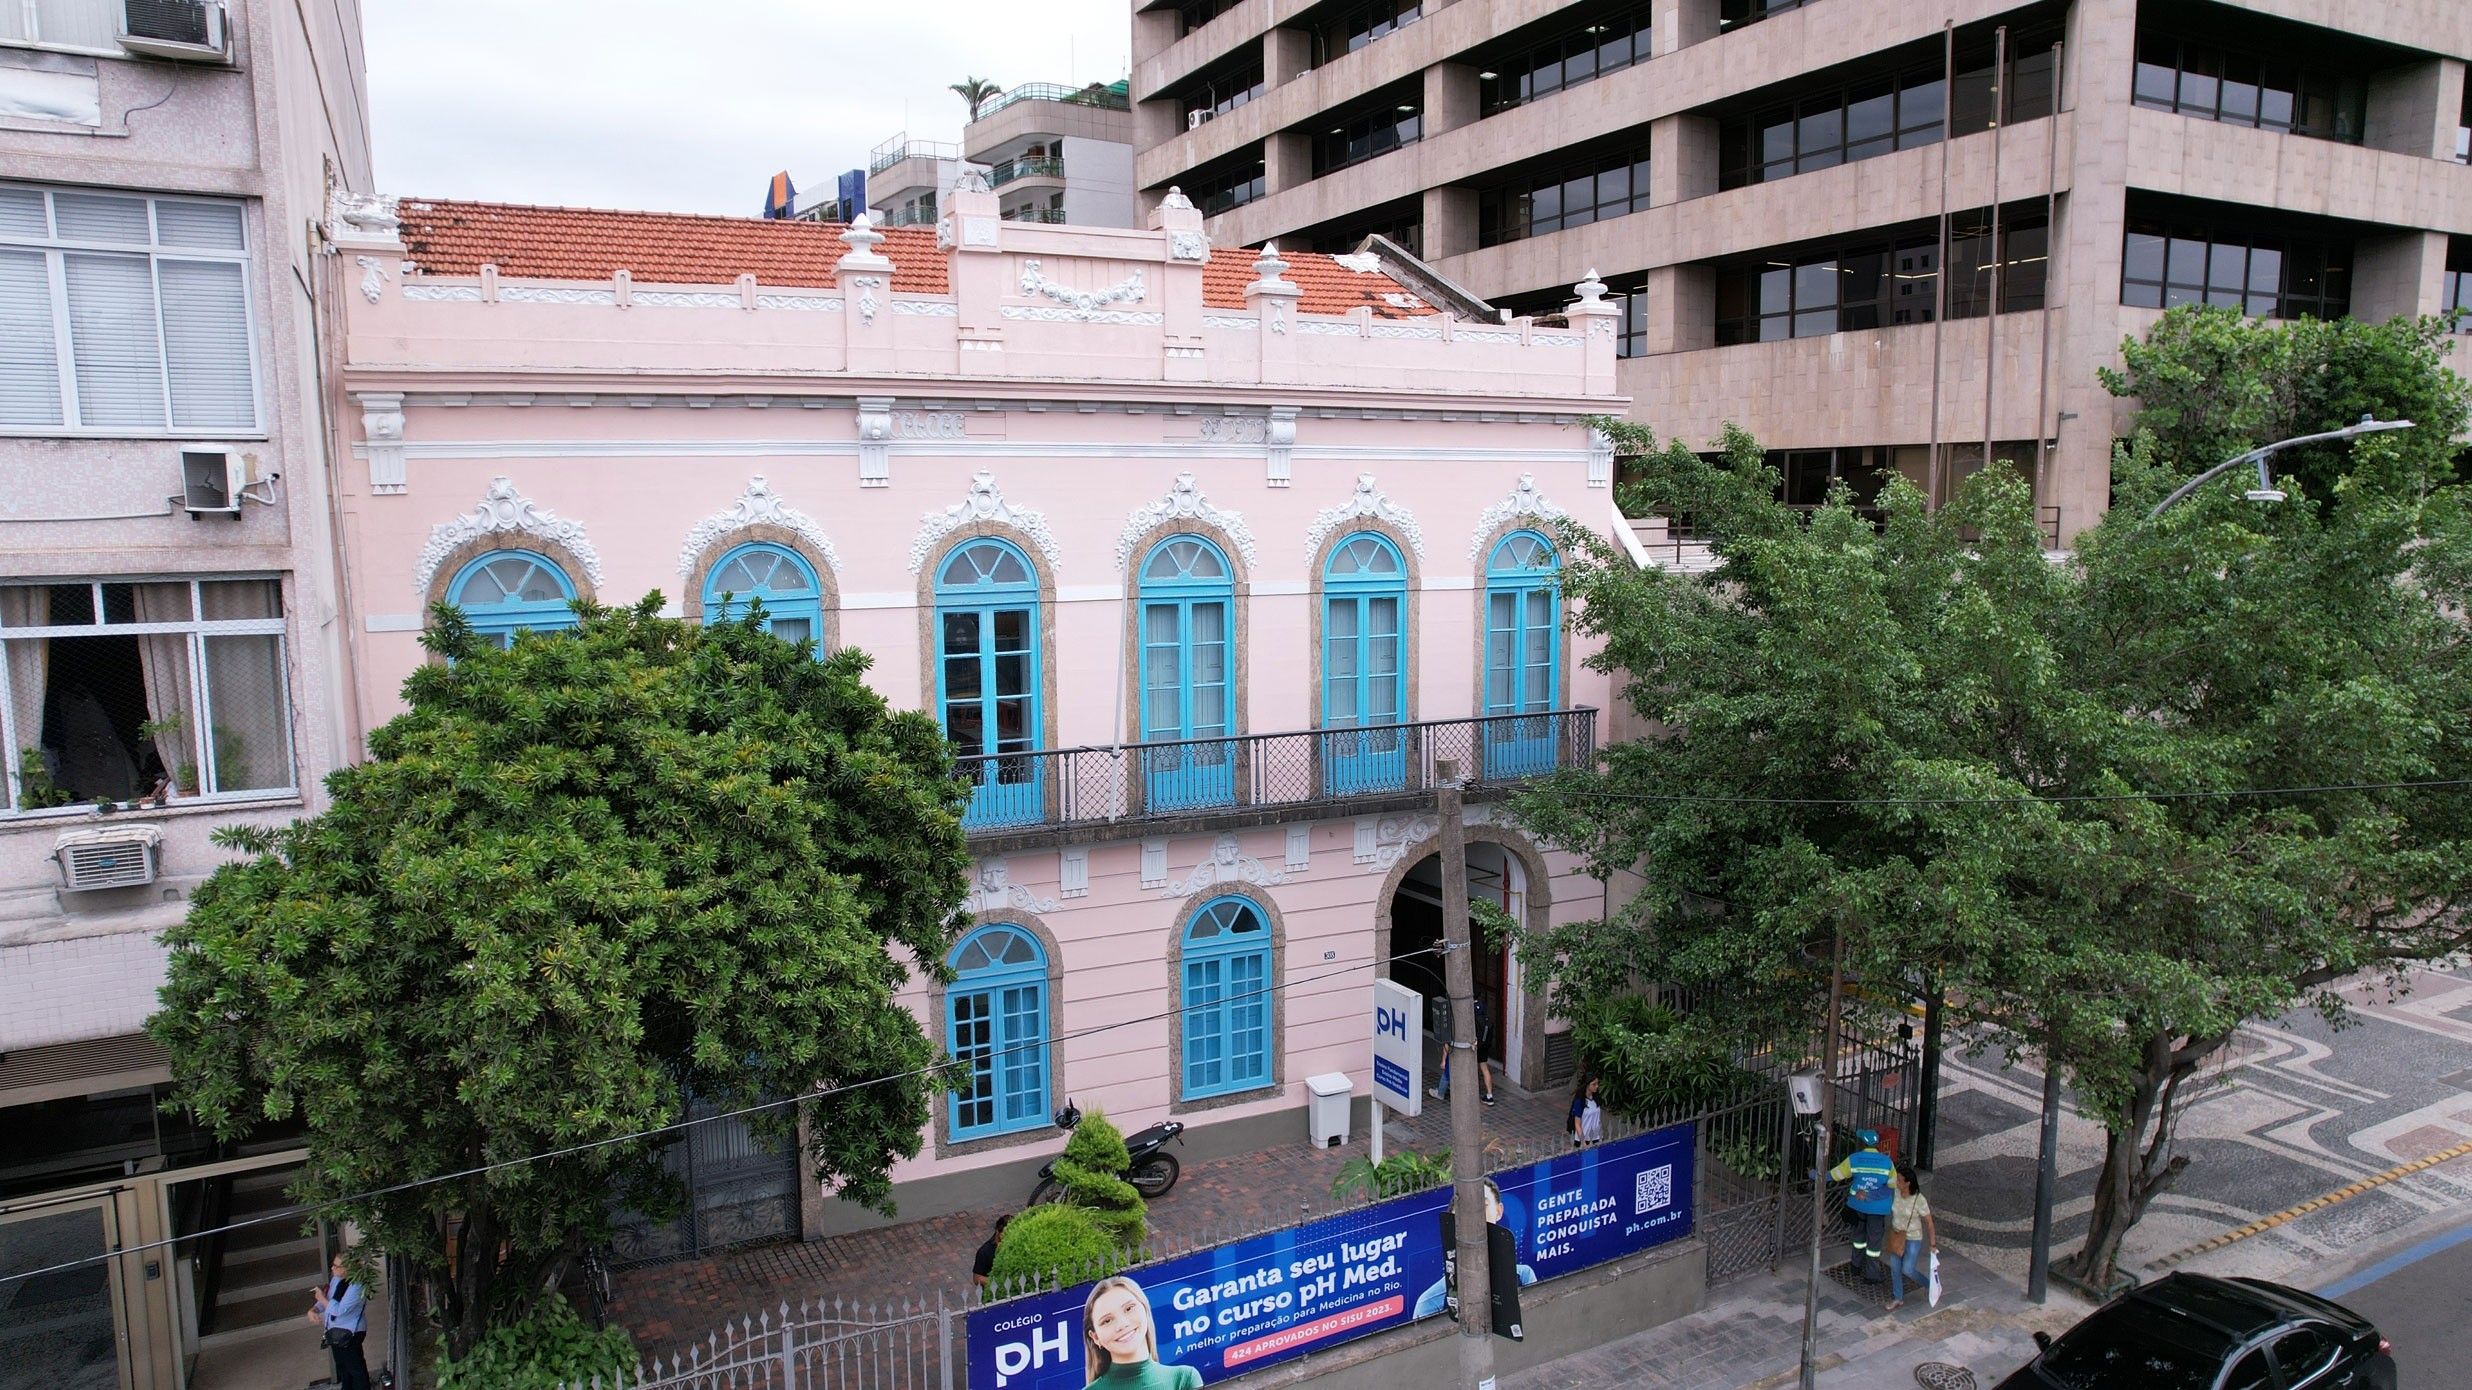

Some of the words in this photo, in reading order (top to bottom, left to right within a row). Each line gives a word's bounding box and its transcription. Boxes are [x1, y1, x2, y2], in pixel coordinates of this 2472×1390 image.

[1376, 1006, 1406, 1042] pH
[1538, 1197, 1616, 1227] PREPARADA
[1539, 1189, 1582, 1210] GENTE
[1537, 1214, 1616, 1244] CONQUISTA
[1626, 1211, 1682, 1236] ph.com.br
[1537, 1243, 1574, 1261] MAIS.
[1173, 1268, 1282, 1310] Garanta
[1290, 1253, 1334, 1278] seu
[1341, 1232, 1407, 1263] lugar
[1174, 1316, 1210, 1339] no
[1218, 1292, 1292, 1325] curso
[1300, 1272, 1336, 1306] pH
[1343, 1256, 1401, 1289] Med.
[994, 1314, 1042, 1333] COLÉGIO
[1175, 1345, 1183, 1356] A
[1188, 1335, 1225, 1351] melhor
[1230, 1315, 1291, 1340] preparação
[1294, 1307, 1317, 1325] para
[1319, 1292, 1365, 1312] Medicina
[1367, 1287, 1381, 1297] no
[1384, 1282, 1402, 1293] Rio.
[1232, 1347, 1251, 1359] 424
[1255, 1327, 1318, 1352] APROVADOS
[1323, 1320, 1338, 1333] NO
[1341, 1313, 1362, 1325] SISU
[1367, 1305, 1392, 1317] 2023.
[995, 1320, 1068, 1388] pH
